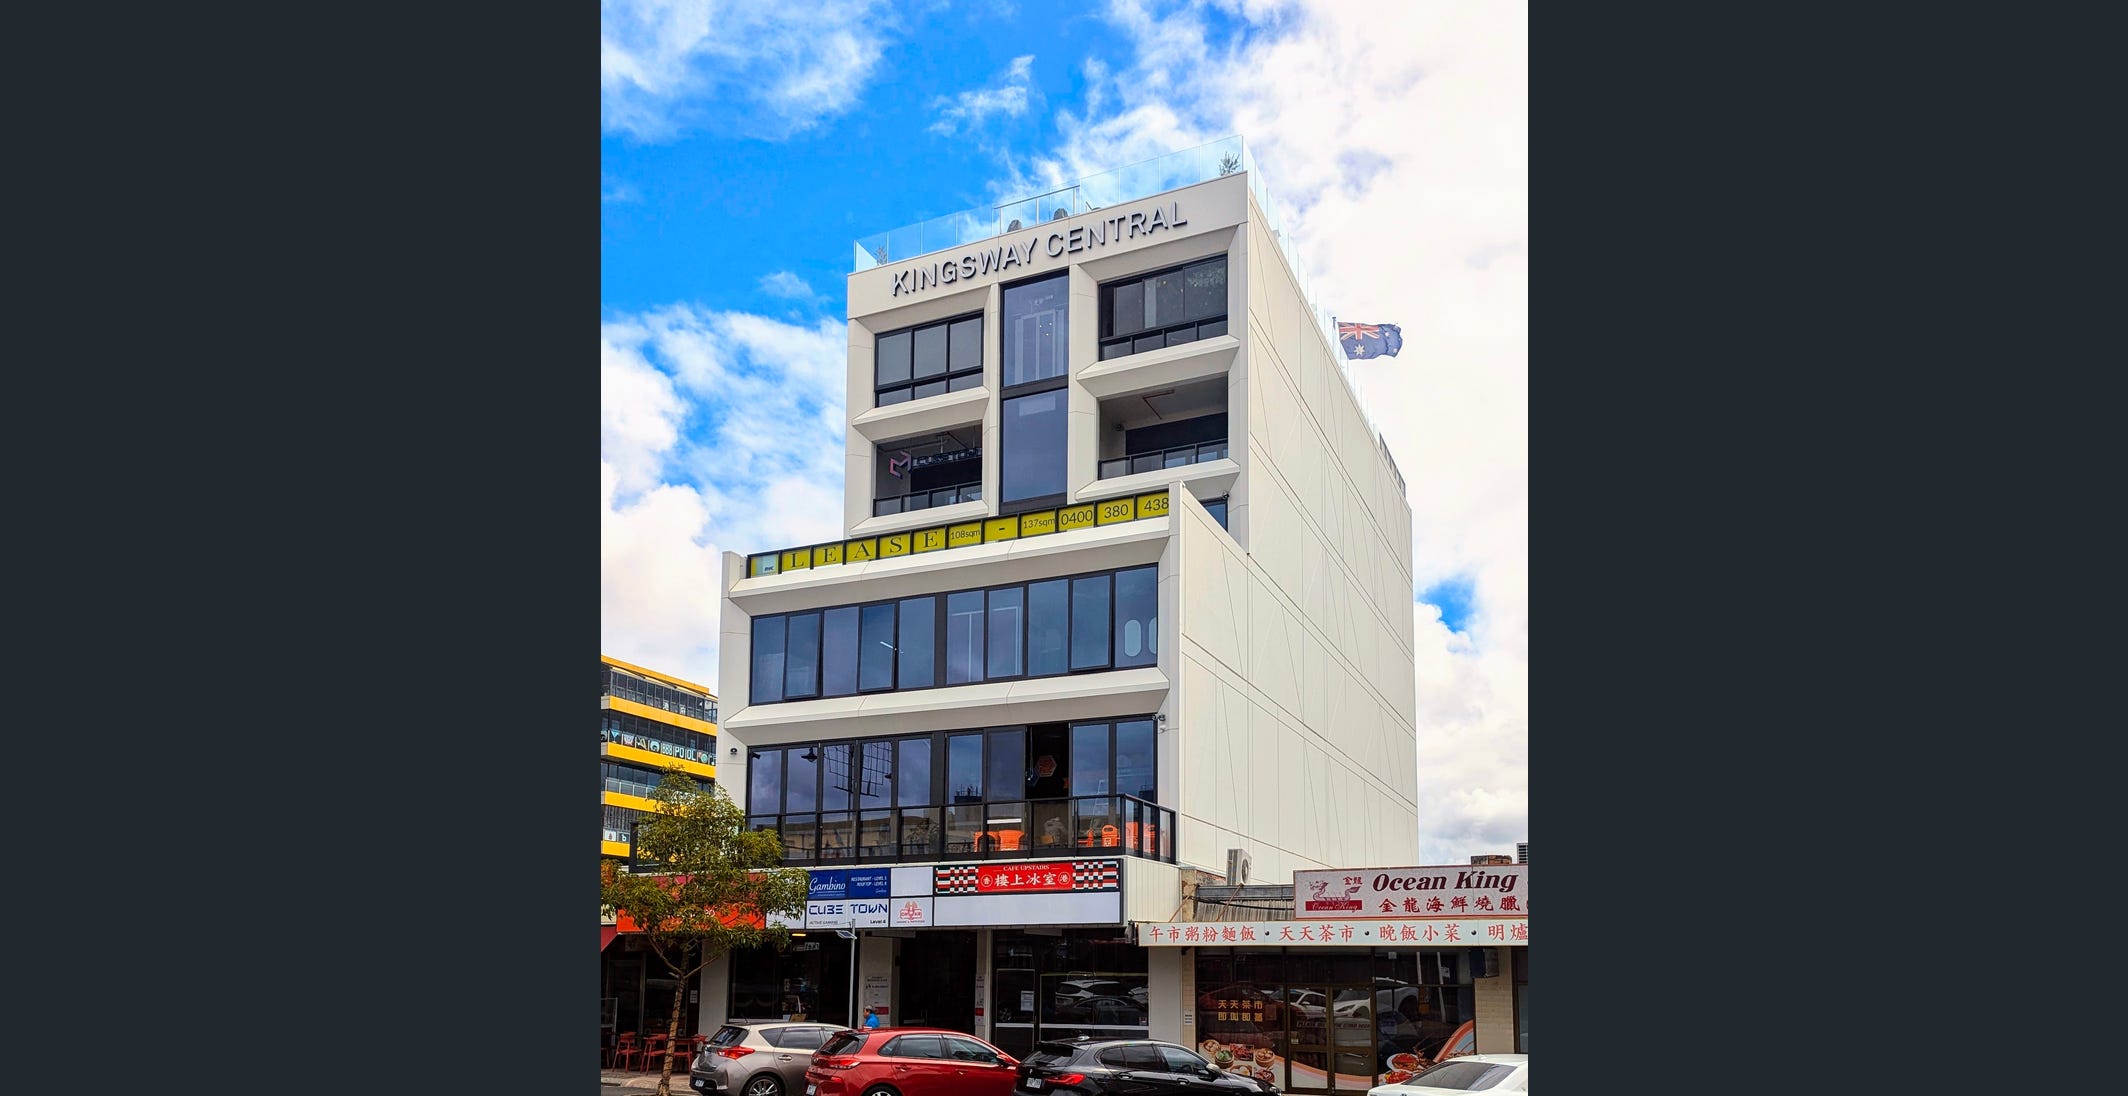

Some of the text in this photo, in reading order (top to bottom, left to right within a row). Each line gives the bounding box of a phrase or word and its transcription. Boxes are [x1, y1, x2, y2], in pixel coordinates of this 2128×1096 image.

[891, 201, 1188, 297] KINGSWAY CENTRAL
[790, 531, 938, 568] LEASE
[950, 528, 981, 541] 108sqm
[1023, 516, 1056, 530] 137sqm
[1061, 509, 1093, 526] 0400
[1103, 503, 1129, 519] 380
[1143, 496, 1169, 512] 438
[809, 876, 846, 895] Gambino
[994, 872, 1058, 887] 樓上冰室
[1372, 873, 1447, 892] Ocean
[1454, 870, 1519, 893] King
[808, 903, 888, 915] CUBE TOWN
[1312, 902, 1358, 913] Ocean King
[1378, 896, 1528, 913] 金龍海鮮燒臘
[1149, 922, 1528, 943] 午市粥粉麵飯 天天茶市 晚飯小菜 明爐
[1218, 999, 1263, 1010] 天天茶市
